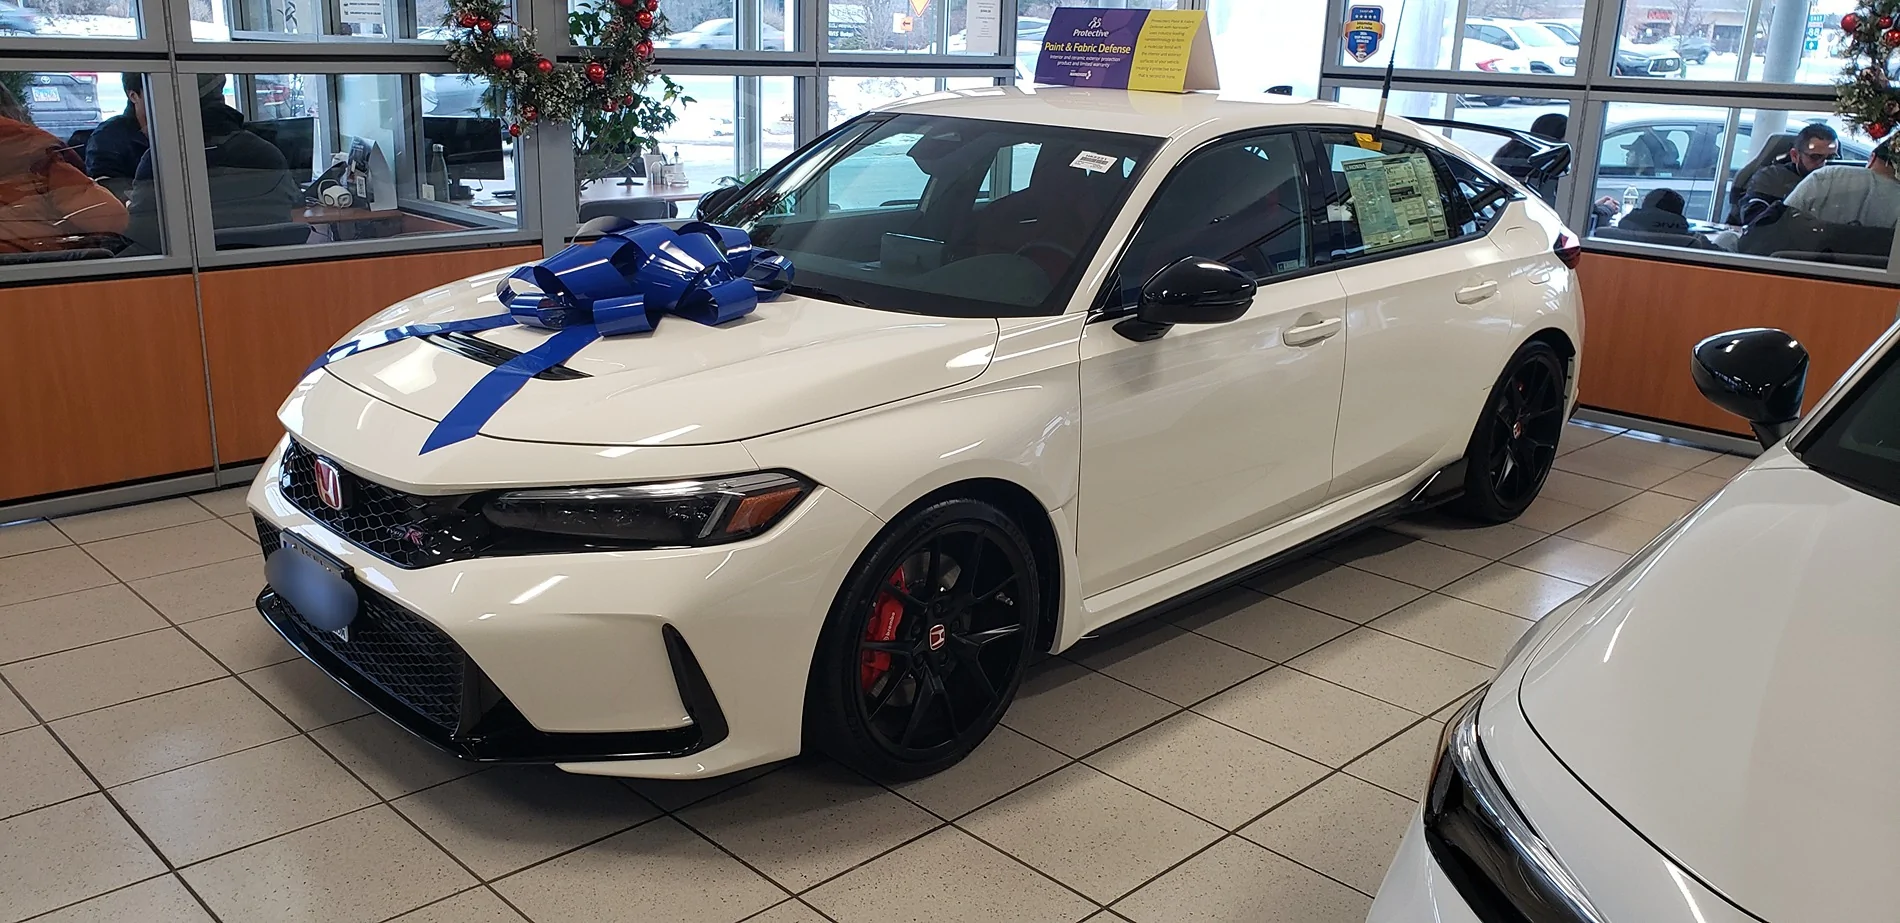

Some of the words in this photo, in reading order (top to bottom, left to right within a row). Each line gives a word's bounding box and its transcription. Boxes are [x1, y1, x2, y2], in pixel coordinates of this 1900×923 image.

[1073, 29, 1109, 38] Protective
[1044, 42, 1064, 51] Paint
[1065, 43, 1073, 52] &
[1073, 43, 1098, 52] Fabric
[1098, 44, 1131, 54] Defense
[887, 612, 895, 636] brembo
